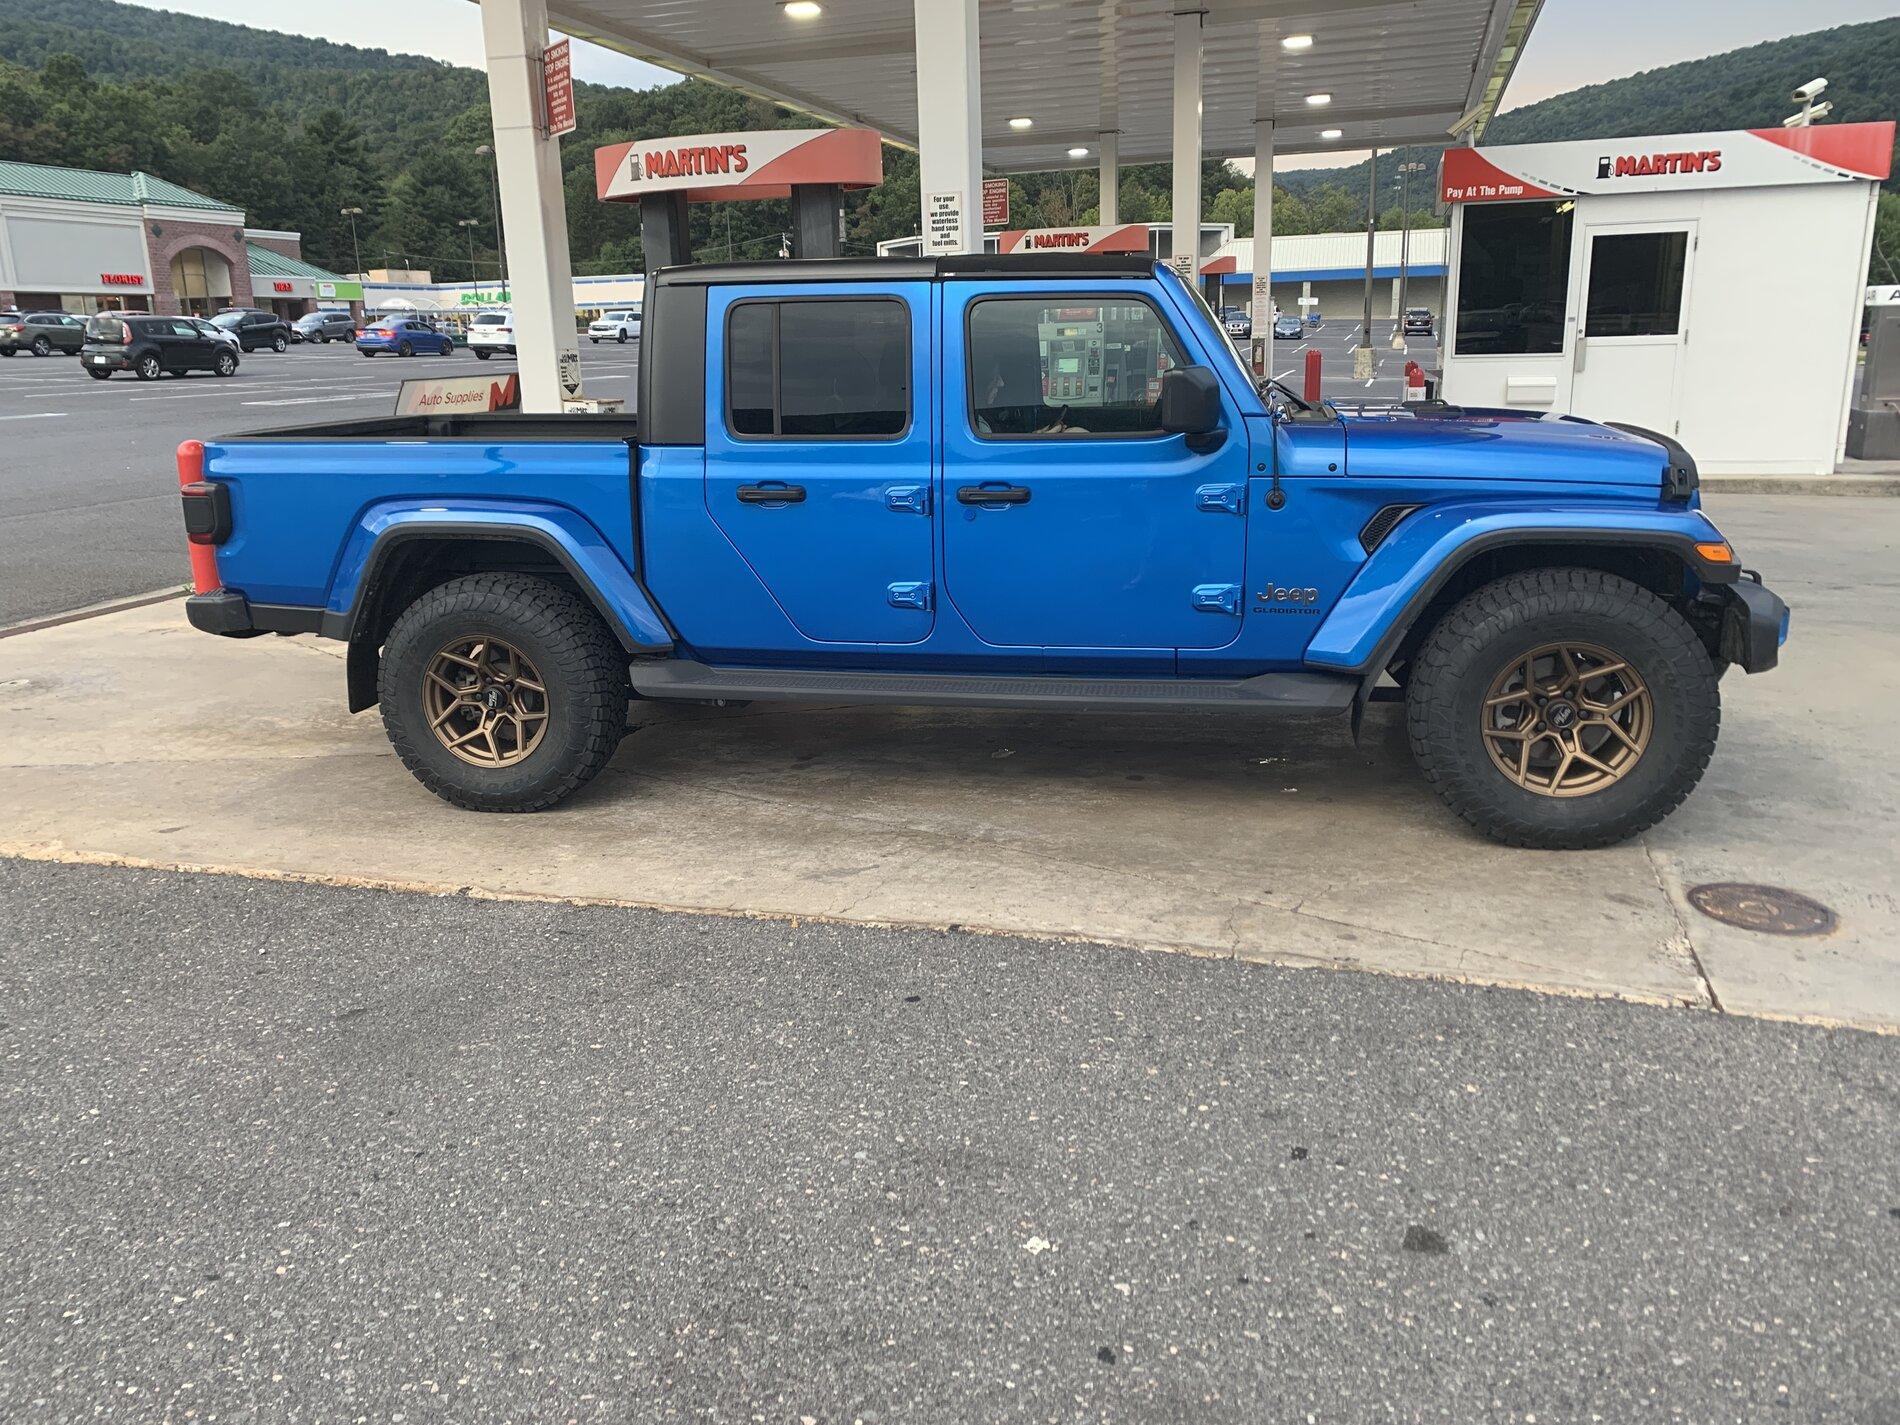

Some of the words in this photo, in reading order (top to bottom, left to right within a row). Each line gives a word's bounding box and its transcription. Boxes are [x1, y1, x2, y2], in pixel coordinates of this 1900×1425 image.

[645, 144, 748, 179] MARTIN'S
[1615, 151, 1721, 177] MARTIN'S
[1446, 187, 1463, 198] Pay
[1466, 186, 1477, 197] At
[1480, 185, 1496, 196] The
[1499, 184, 1524, 195] Pump
[932, 217, 958, 225] waterless
[1034, 232, 1090, 249] MARTIN'S
[1096, 322, 1103, 334] 3
[419, 394, 443, 406] Auto
[445, 390, 484, 406] Supplies
[1256, 582, 1318, 607] Jeep
[1253, 607, 1321, 615] GLADIATOR
